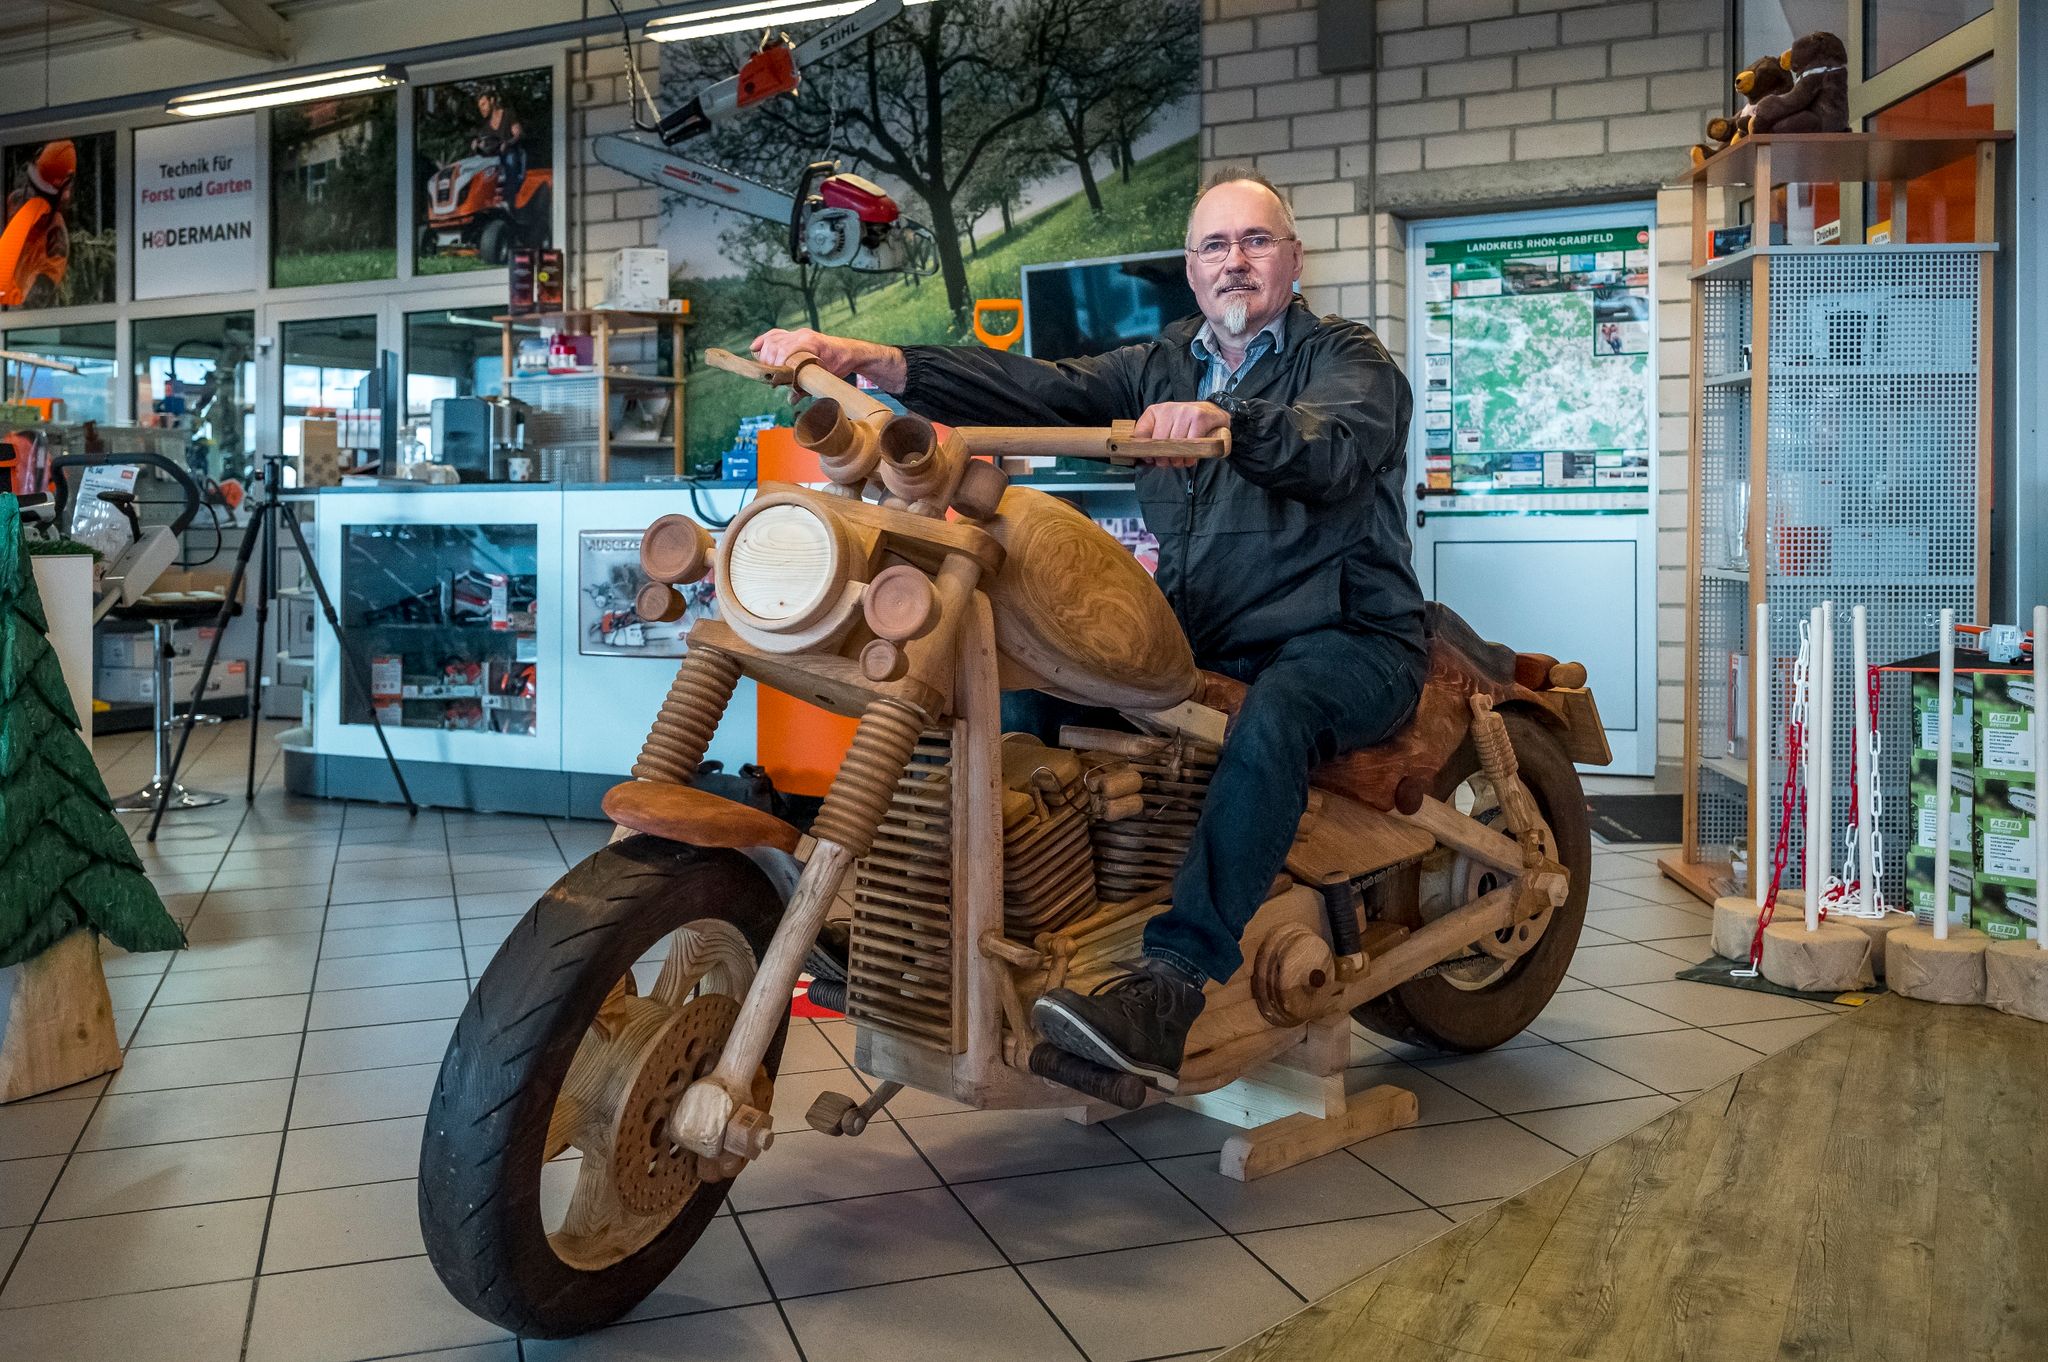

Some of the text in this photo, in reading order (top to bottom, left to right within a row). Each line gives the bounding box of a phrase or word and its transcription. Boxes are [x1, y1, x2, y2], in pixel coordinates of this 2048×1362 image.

[820, 22, 860, 50] STIHL
[159, 156, 234, 179] Technik für
[141, 179, 252, 204] Forst und Garten
[1466, 240, 1524, 253] LANDKREIS
[588, 539, 640, 551] AUSGEZE
